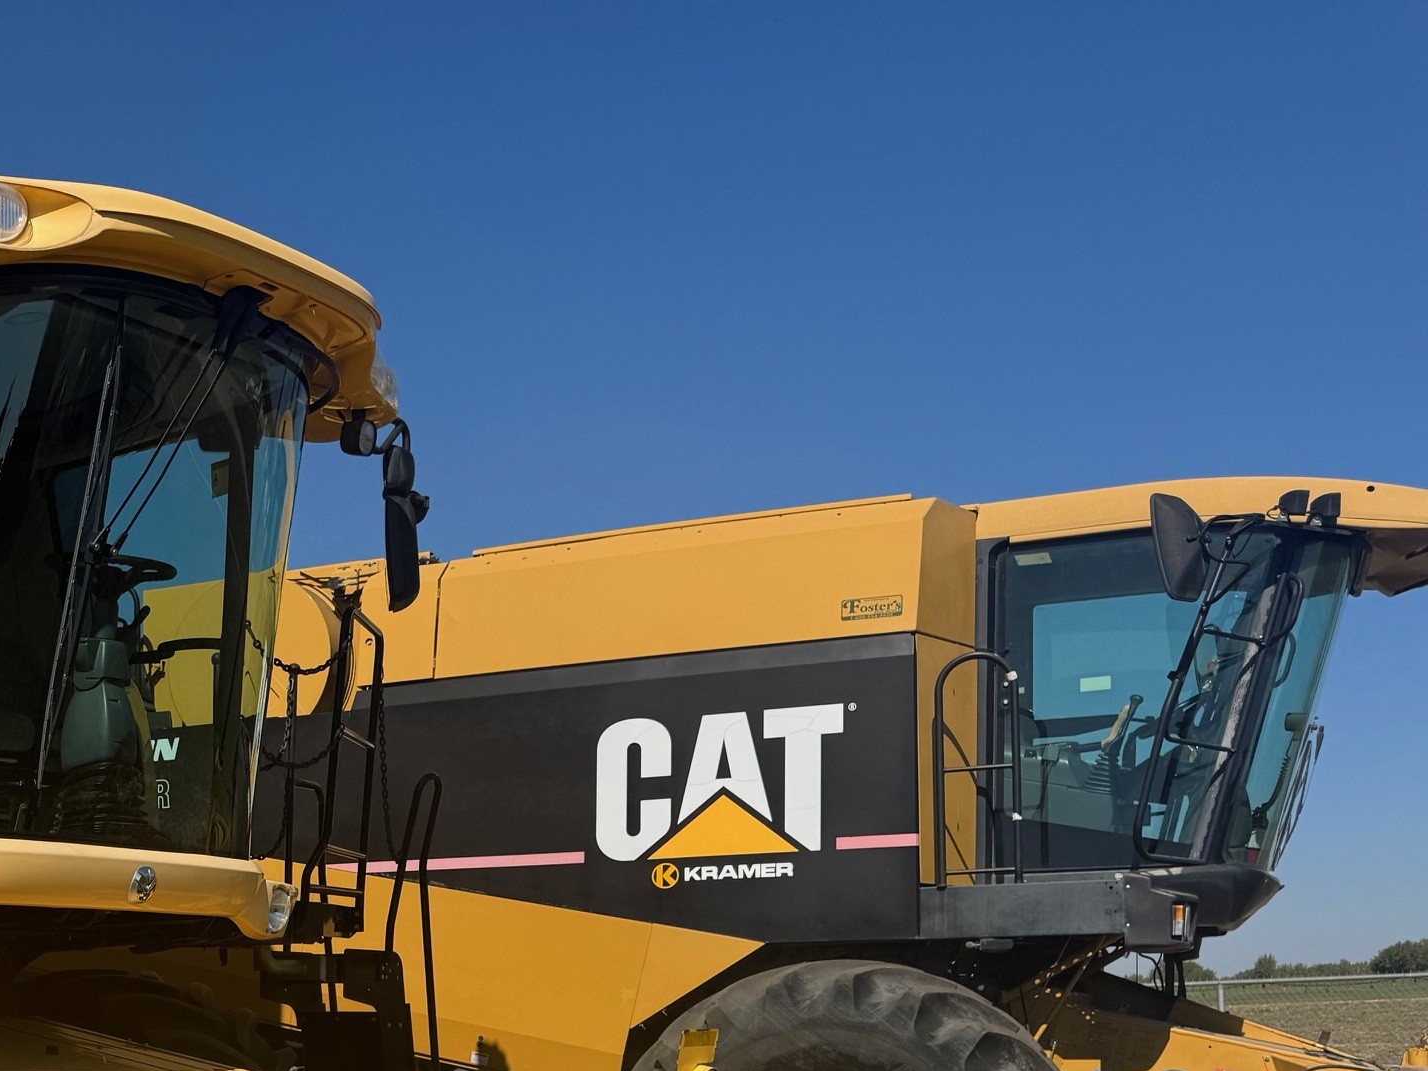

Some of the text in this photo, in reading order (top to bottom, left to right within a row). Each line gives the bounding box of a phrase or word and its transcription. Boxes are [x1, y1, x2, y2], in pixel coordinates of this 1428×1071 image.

[843, 599, 902, 614] Foster's
[595, 703, 844, 862] CAT
[684, 862, 794, 882] KRAMER
